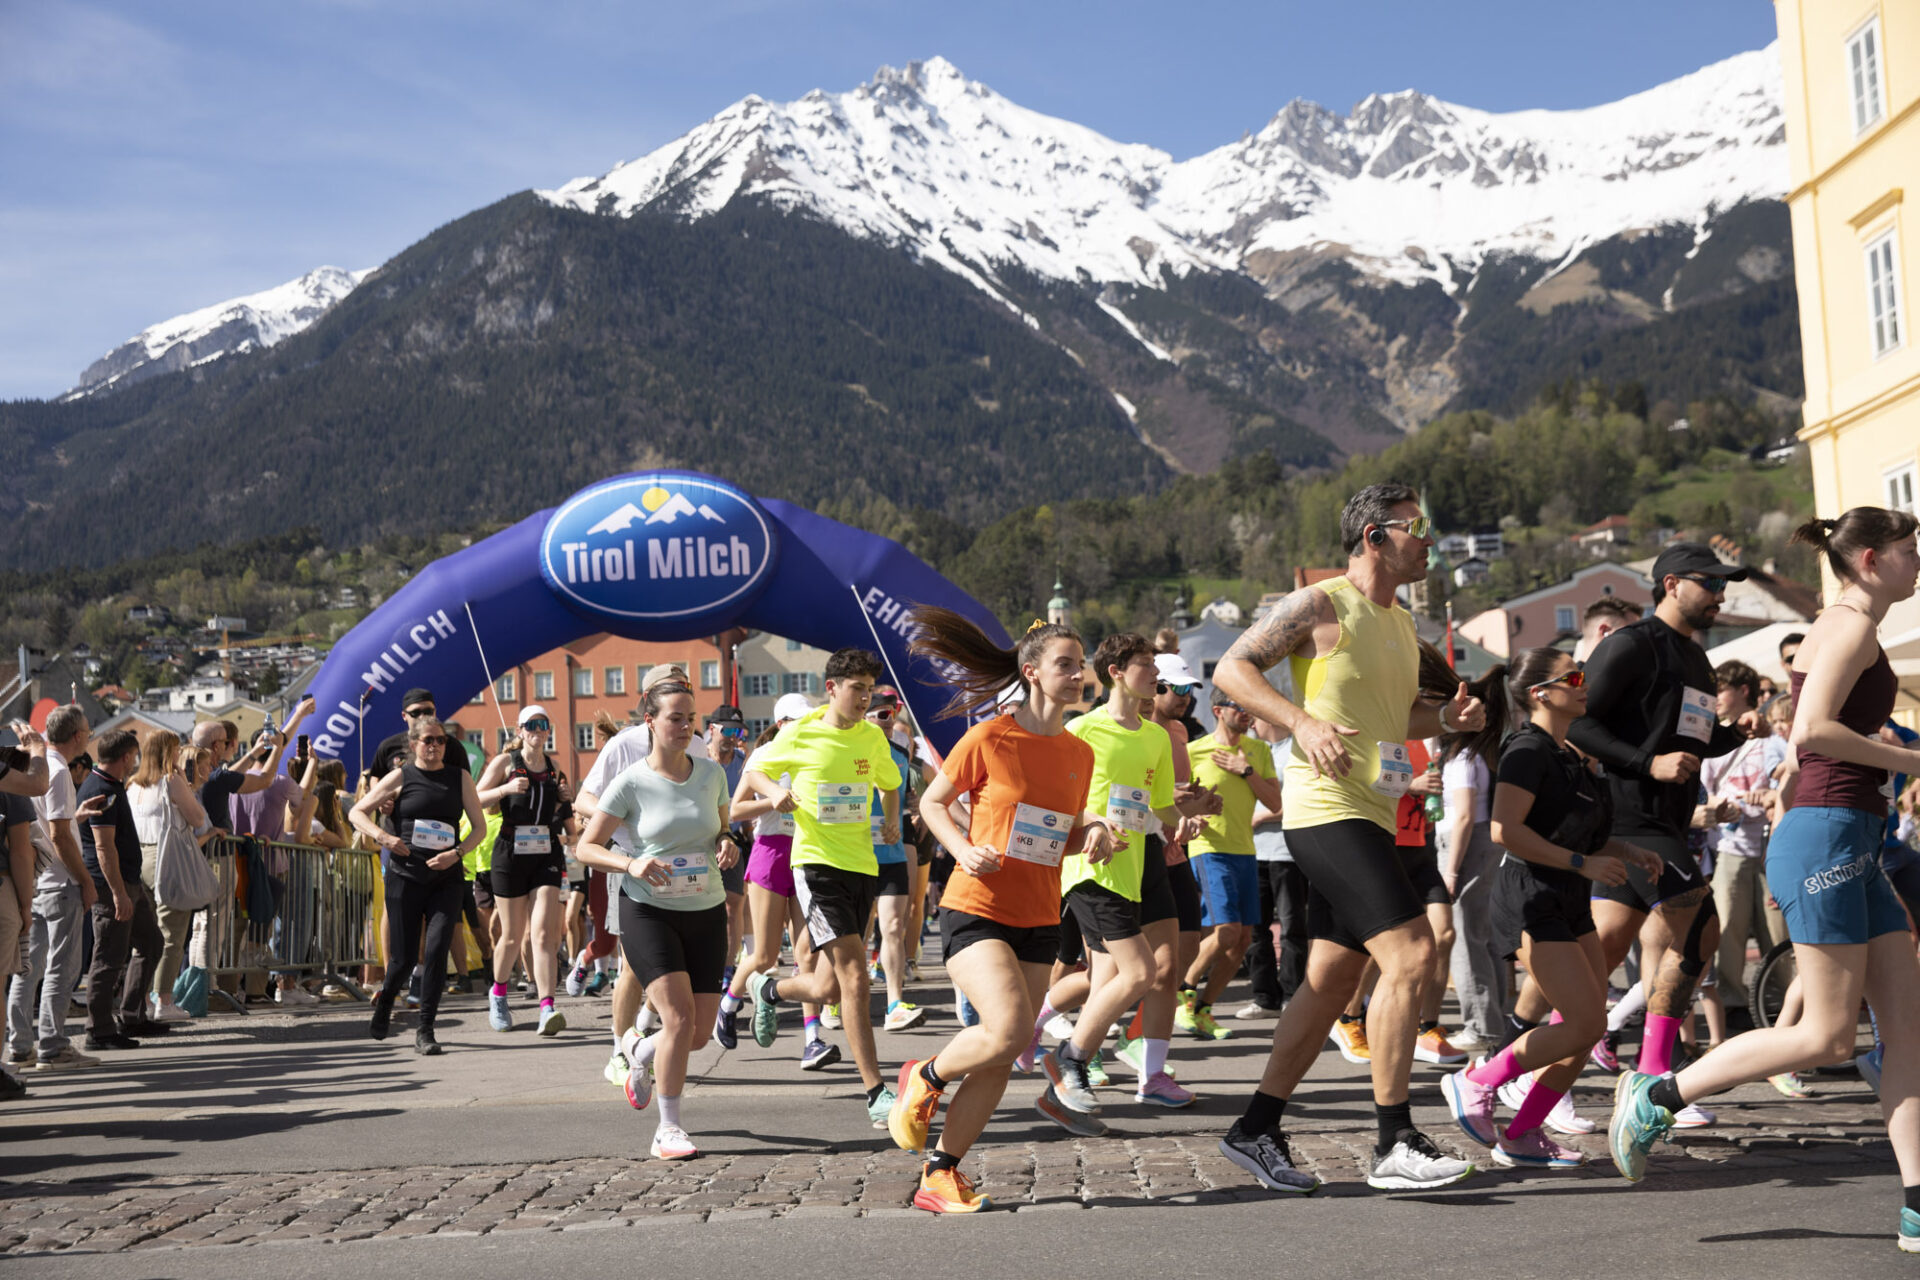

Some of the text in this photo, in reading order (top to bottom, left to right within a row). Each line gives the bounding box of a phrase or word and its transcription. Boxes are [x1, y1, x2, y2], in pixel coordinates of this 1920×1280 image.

[561, 535, 751, 584] Tirol Milch
[312, 608, 457, 758] ROL MILCH
[1050, 840, 1058, 850] 43
[688, 875, 698, 883] 94
[1804, 852, 1875, 895] skin
